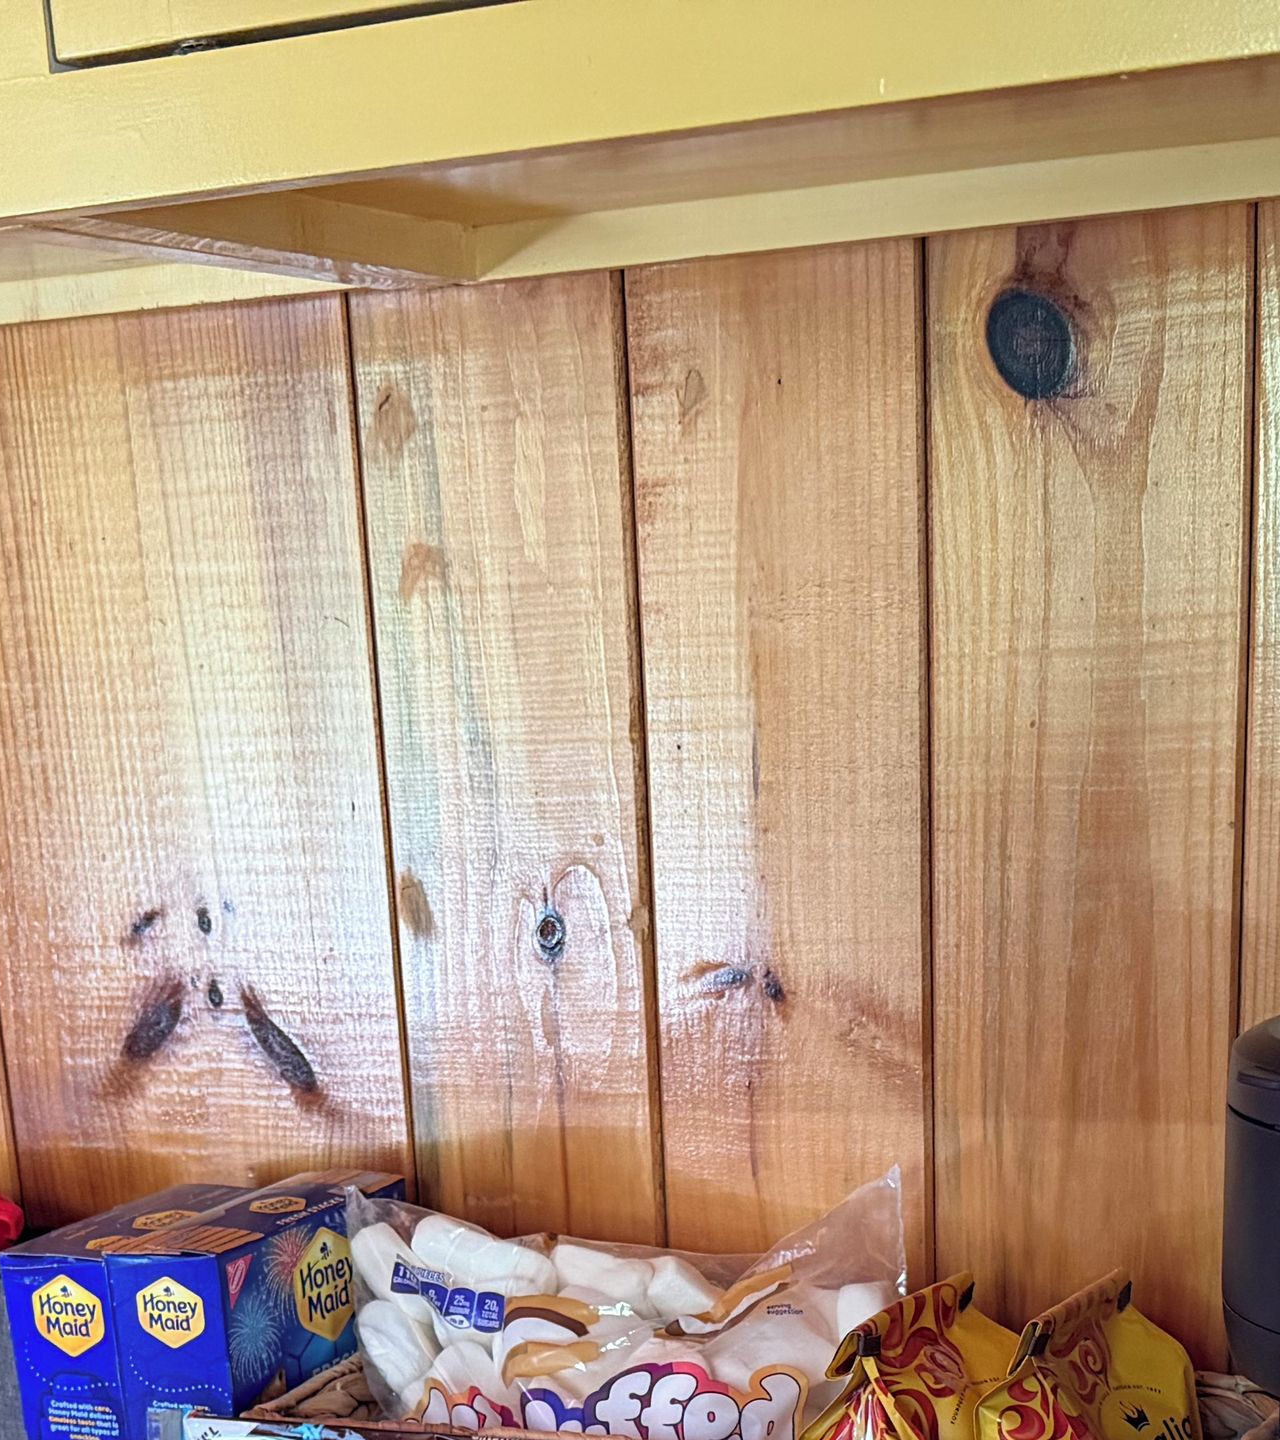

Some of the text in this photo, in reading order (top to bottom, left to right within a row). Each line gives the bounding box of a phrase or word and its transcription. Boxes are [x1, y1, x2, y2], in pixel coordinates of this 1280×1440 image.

[299, 1256, 354, 1299] Honey
[38, 1293, 97, 1324] Honey
[142, 1293, 198, 1320] Honey
[307, 1284, 352, 1323] Maid
[46, 1314, 91, 1339] Maid
[149, 1312, 191, 1332] Maid
